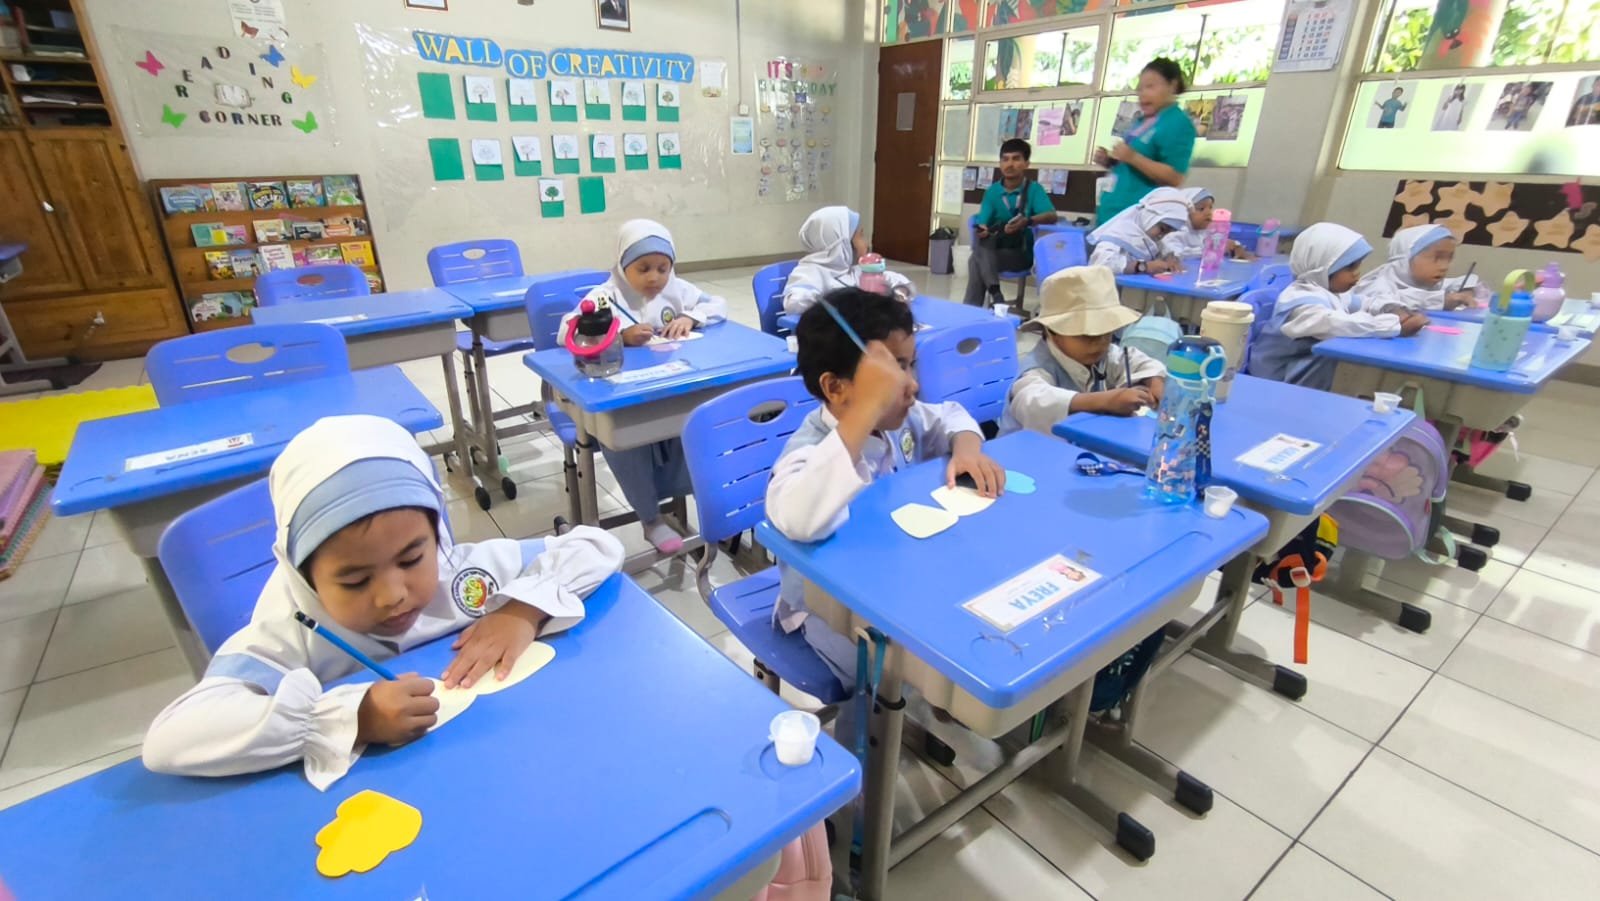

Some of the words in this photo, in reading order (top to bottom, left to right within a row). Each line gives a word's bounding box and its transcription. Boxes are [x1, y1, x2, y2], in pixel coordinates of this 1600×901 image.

[415, 33, 501, 65] WALL
[508, 53, 546, 78] OF
[551, 51, 694, 80] CREATIVITY
[767, 60, 793, 79] IT'S
[199, 110, 282, 127] CORNER
[1008, 581, 1061, 611] FREYA
